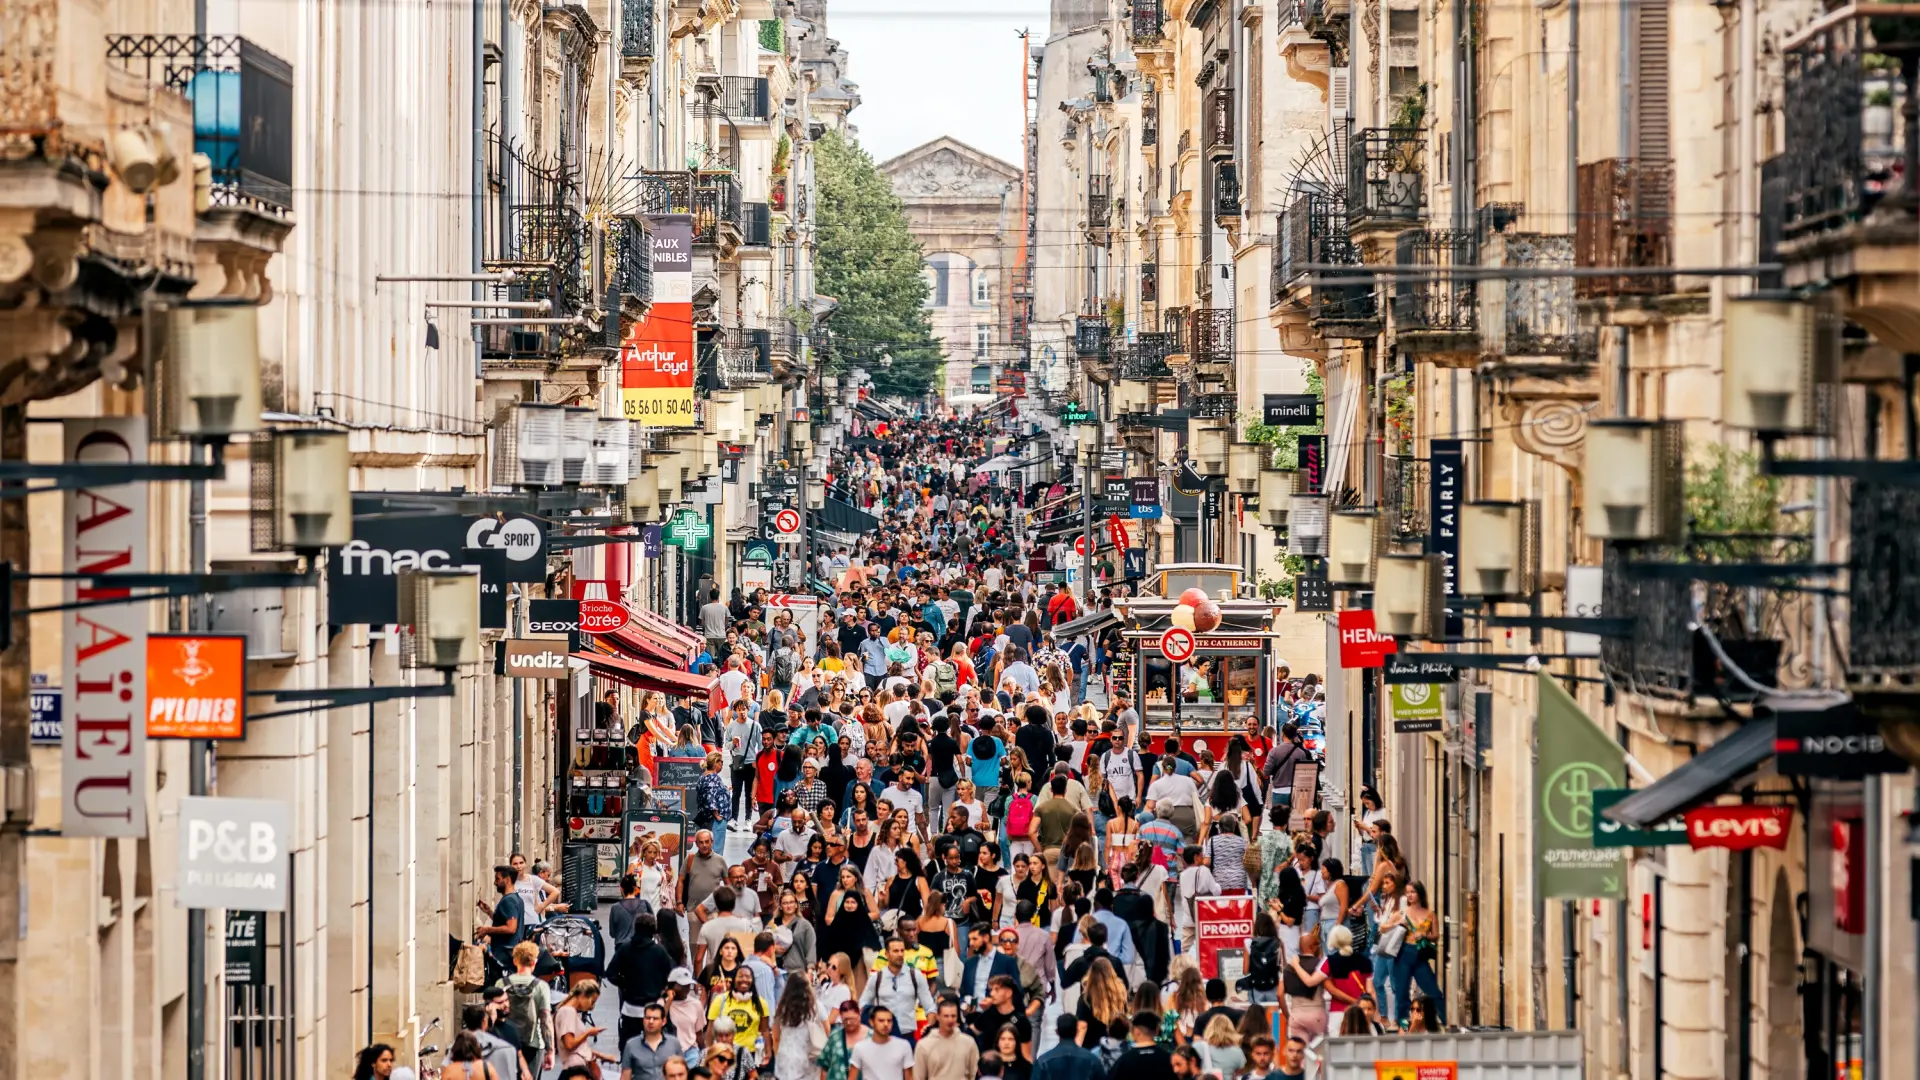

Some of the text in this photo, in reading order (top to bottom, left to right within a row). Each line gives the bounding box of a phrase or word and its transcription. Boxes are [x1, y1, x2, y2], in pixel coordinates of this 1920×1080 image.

[652, 252, 688, 263] NIBLES
[626, 343, 676, 362] Arthur
[653, 352, 688, 376] Loyd
[624, 399, 692, 415] 05 56 01 50 40
[1271, 404, 1310, 416] minelli
[1440, 463, 1454, 537] FAIRLY
[1138, 505, 1153, 514] tbs
[504, 533, 536, 547] SPORT
[340, 539, 451, 576] fnac
[582, 603, 613, 613] Brioche
[529, 622, 579, 632] GEOX
[1207, 639, 1259, 647] CATHERINE
[1342, 628, 1395, 644] HEMA
[510, 651, 564, 669] undiz
[149, 697, 237, 723] PYLONES
[188, 818, 278, 864] P&B
[1544, 847, 1621, 864] promenade
[226, 915, 257, 938] ITÉ
[1202, 923, 1250, 935] PROMO
